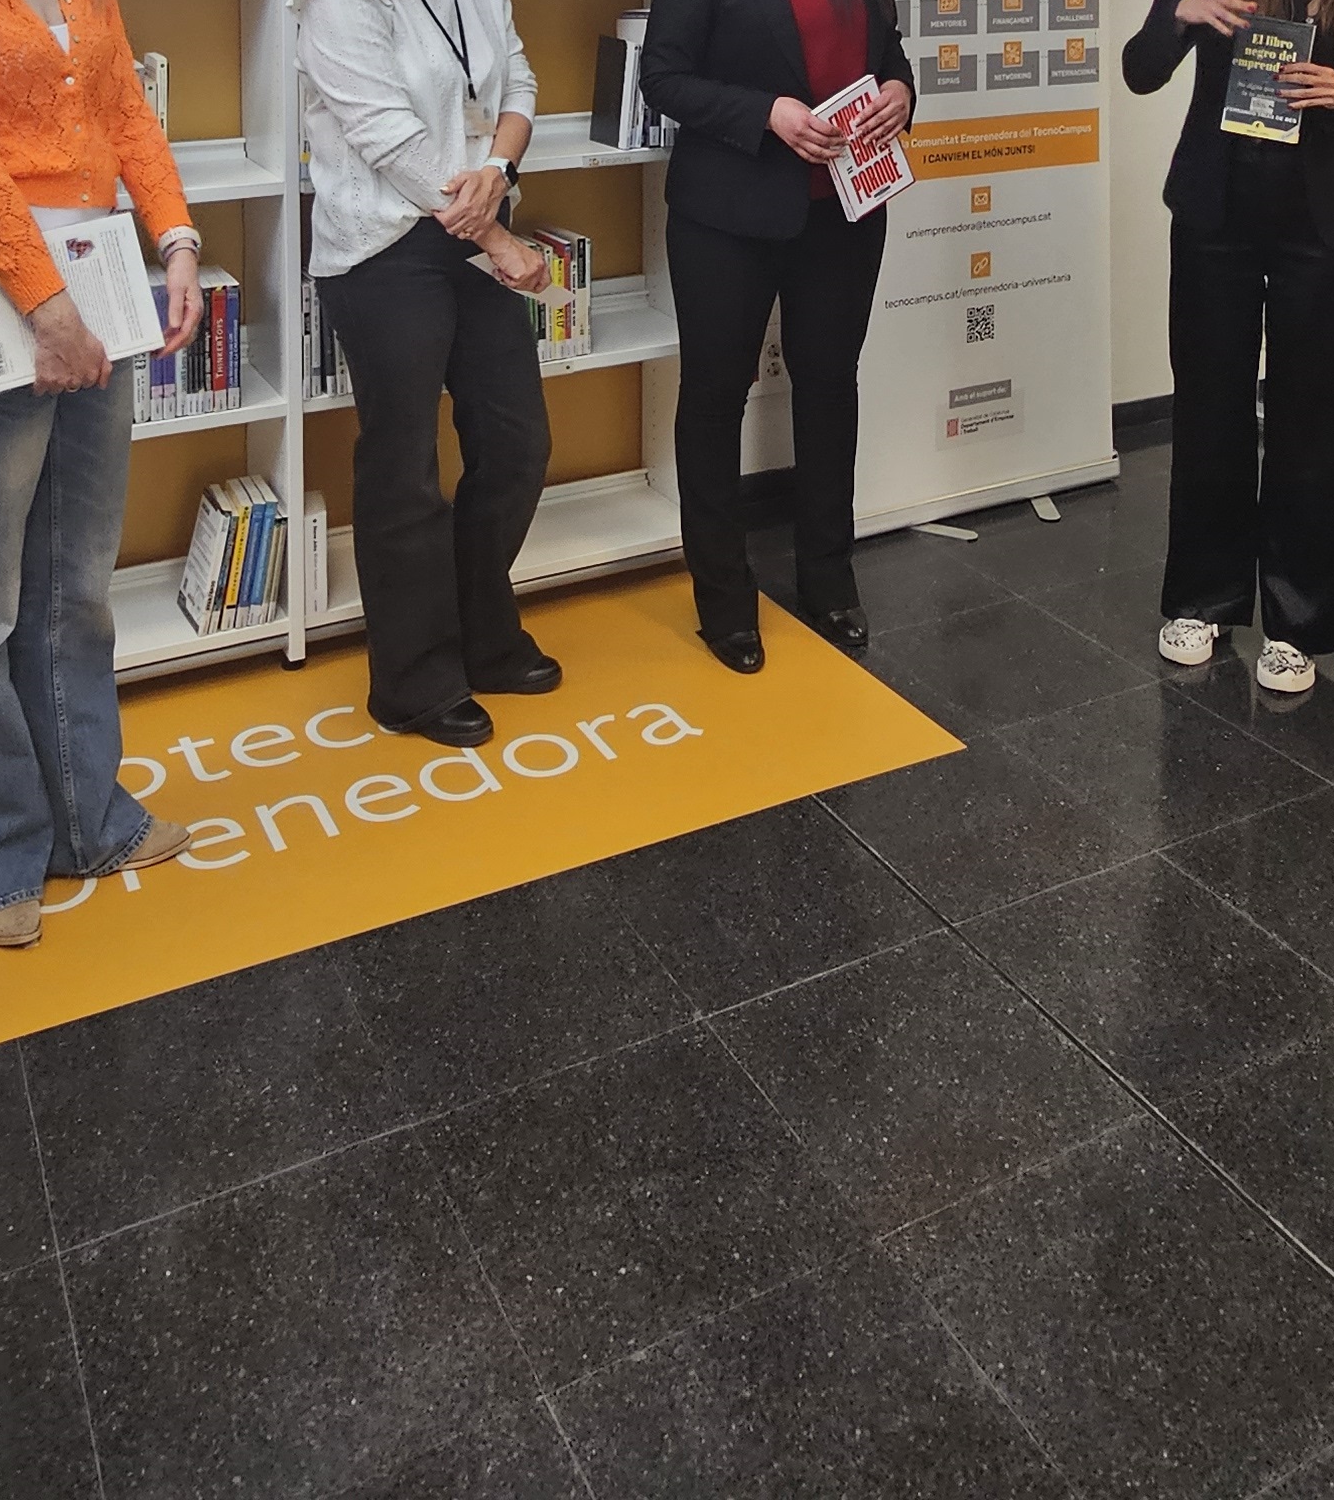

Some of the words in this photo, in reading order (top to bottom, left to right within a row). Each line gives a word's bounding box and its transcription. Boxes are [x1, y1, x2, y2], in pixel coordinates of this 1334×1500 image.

[930, 19, 967, 29] MENTORIES
[992, 16, 1034, 27] FINANÇAMENT
[1251, 33, 1264, 45] El
[1266, 35, 1294, 50] libro
[1244, 46, 1276, 60] negro
[1278, 50, 1297, 63] del
[937, 77, 960, 86] ESPAIS
[911, 135, 959, 148] Comunitat
[961, 131, 1018, 146] Emprenedora
[1032, 124, 1092, 139] TecnoCampus
[928, 150, 971, 164] CANVIEM
[971, 149, 983, 161] EL
[984, 145, 1004, 159] MÓN
[1005, 144, 1036, 156] JUNTS!
